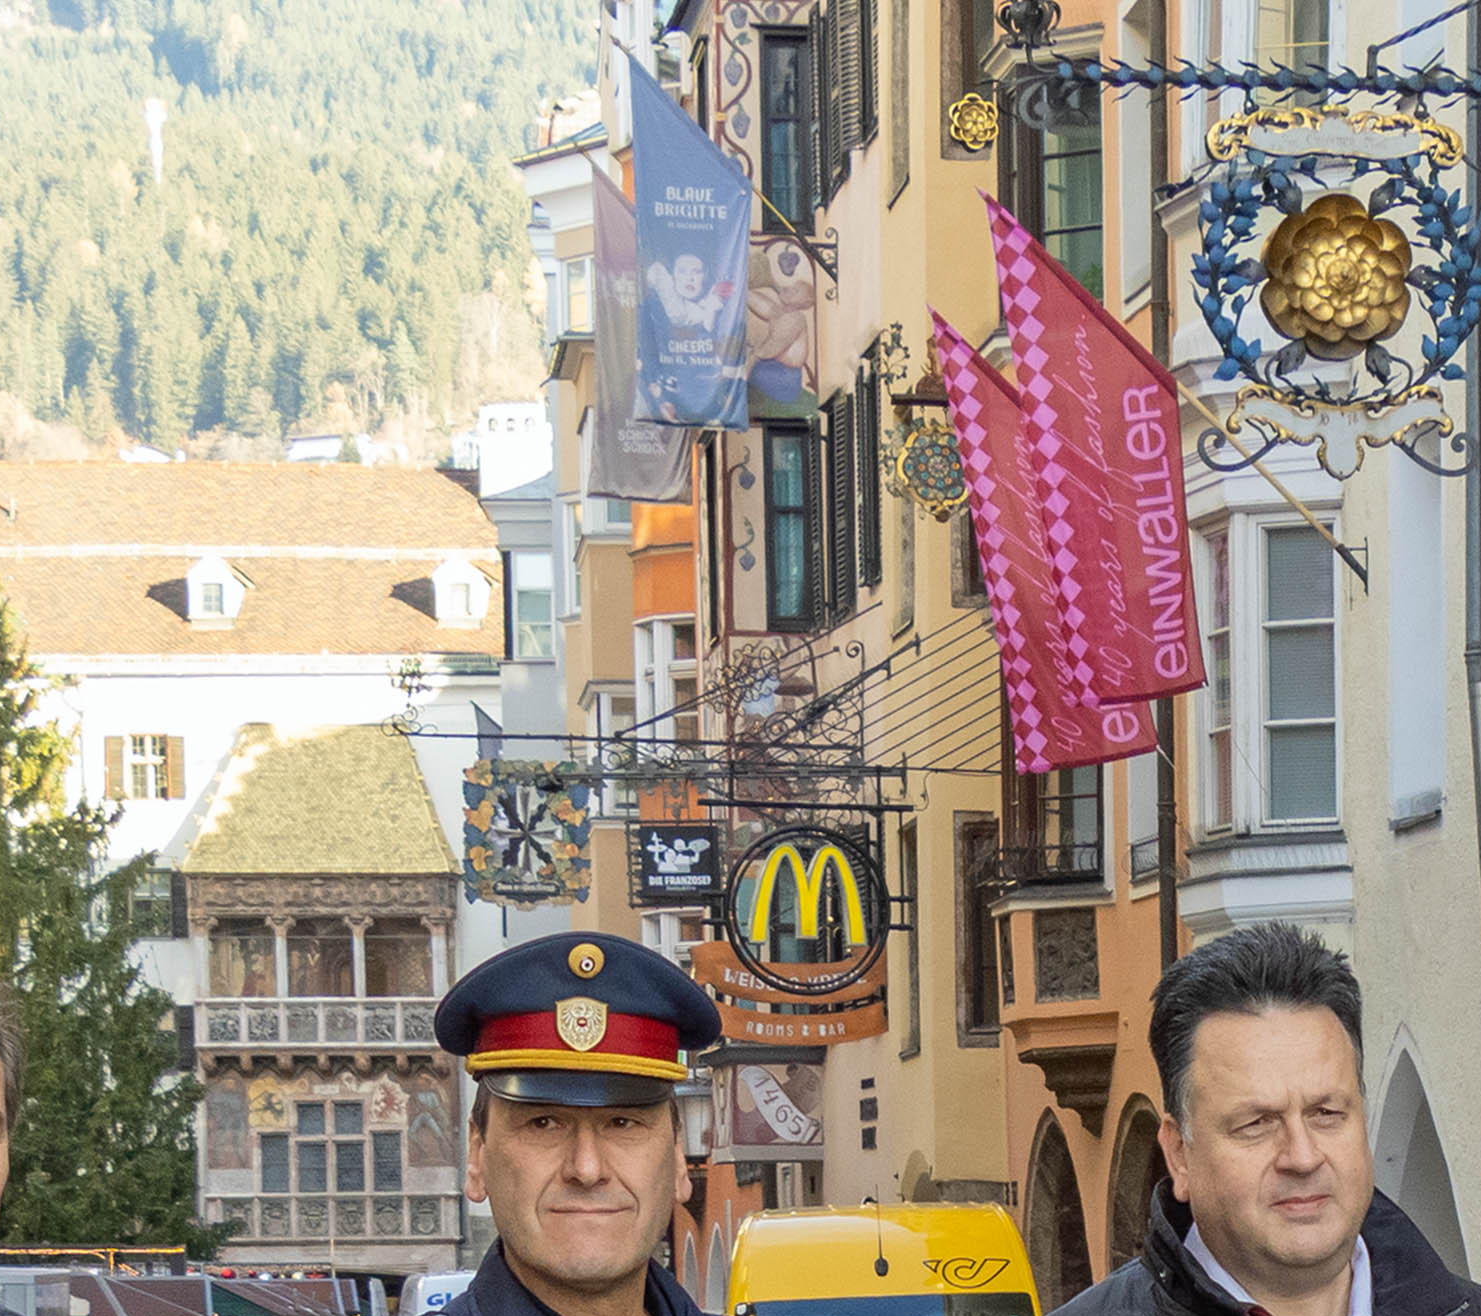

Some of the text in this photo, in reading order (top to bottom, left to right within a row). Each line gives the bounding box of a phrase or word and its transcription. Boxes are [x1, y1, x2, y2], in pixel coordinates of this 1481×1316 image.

[654, 202, 728, 219] BRIGITTE
[1098, 647, 1136, 687] 40
[753, 1076, 806, 1136] 1465
